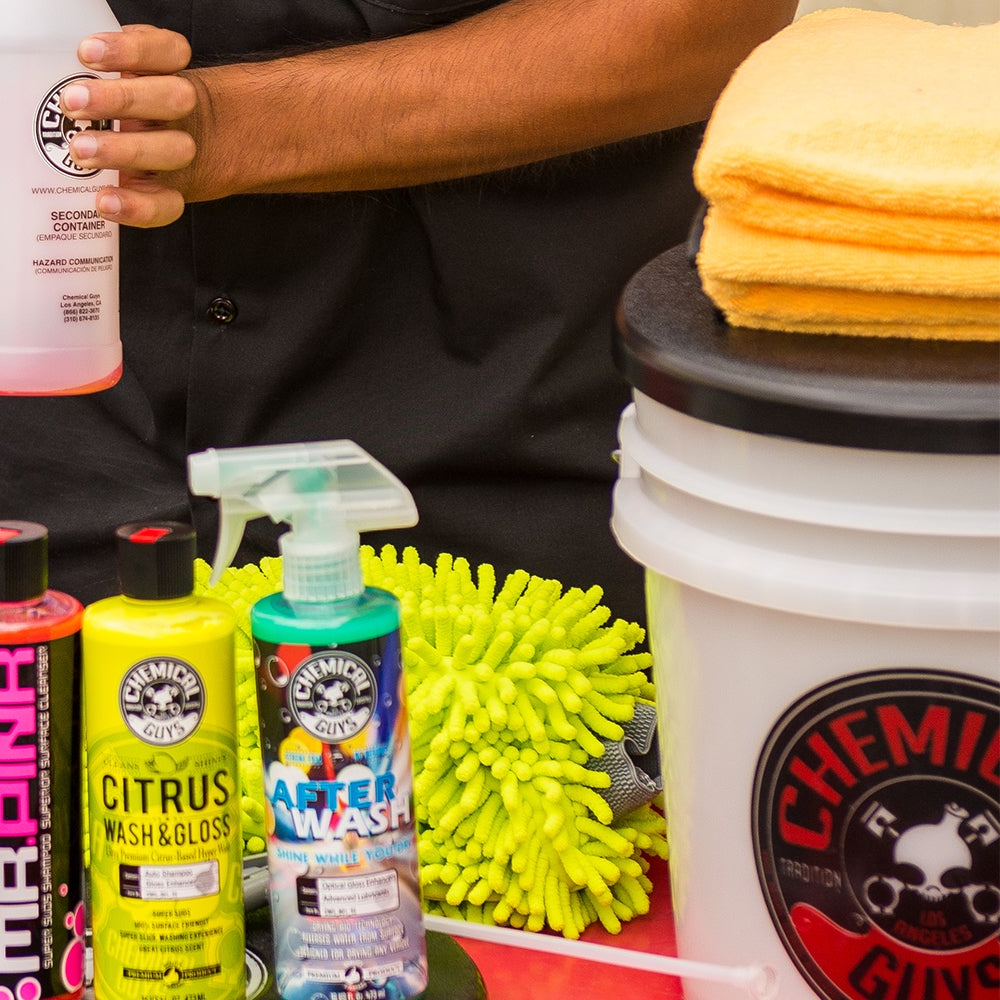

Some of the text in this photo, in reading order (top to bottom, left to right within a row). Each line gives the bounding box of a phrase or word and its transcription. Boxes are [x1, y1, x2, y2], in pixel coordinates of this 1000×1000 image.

[51, 210, 99, 221] SECONDA
[53, 220, 105, 232] CONTAINER
[36, 232, 77, 242] (EMPAQUE
[32, 258, 67, 267] HAZARD
[125, 661, 200, 703] CHEMICAL
[295, 657, 371, 700] CHEMICAL
[143, 720, 185, 739] GUYS
[315, 717, 357, 735] GUYS
[102, 769, 230, 814] CITRUS
[271, 771, 396, 813] AFTER
[36, 645, 53, 970] SUPER SUDS SHAMPOO SUPERIOR SURFACE CLEANSER
[290, 795, 411, 841] WASH
[276, 848, 309, 863] SHINE
[315, 850, 358, 864] WHILE
[365, 846, 393, 861] YOU
[778, 856, 843, 890] TRADITION
[893, 918, 973, 947] ANGELES
